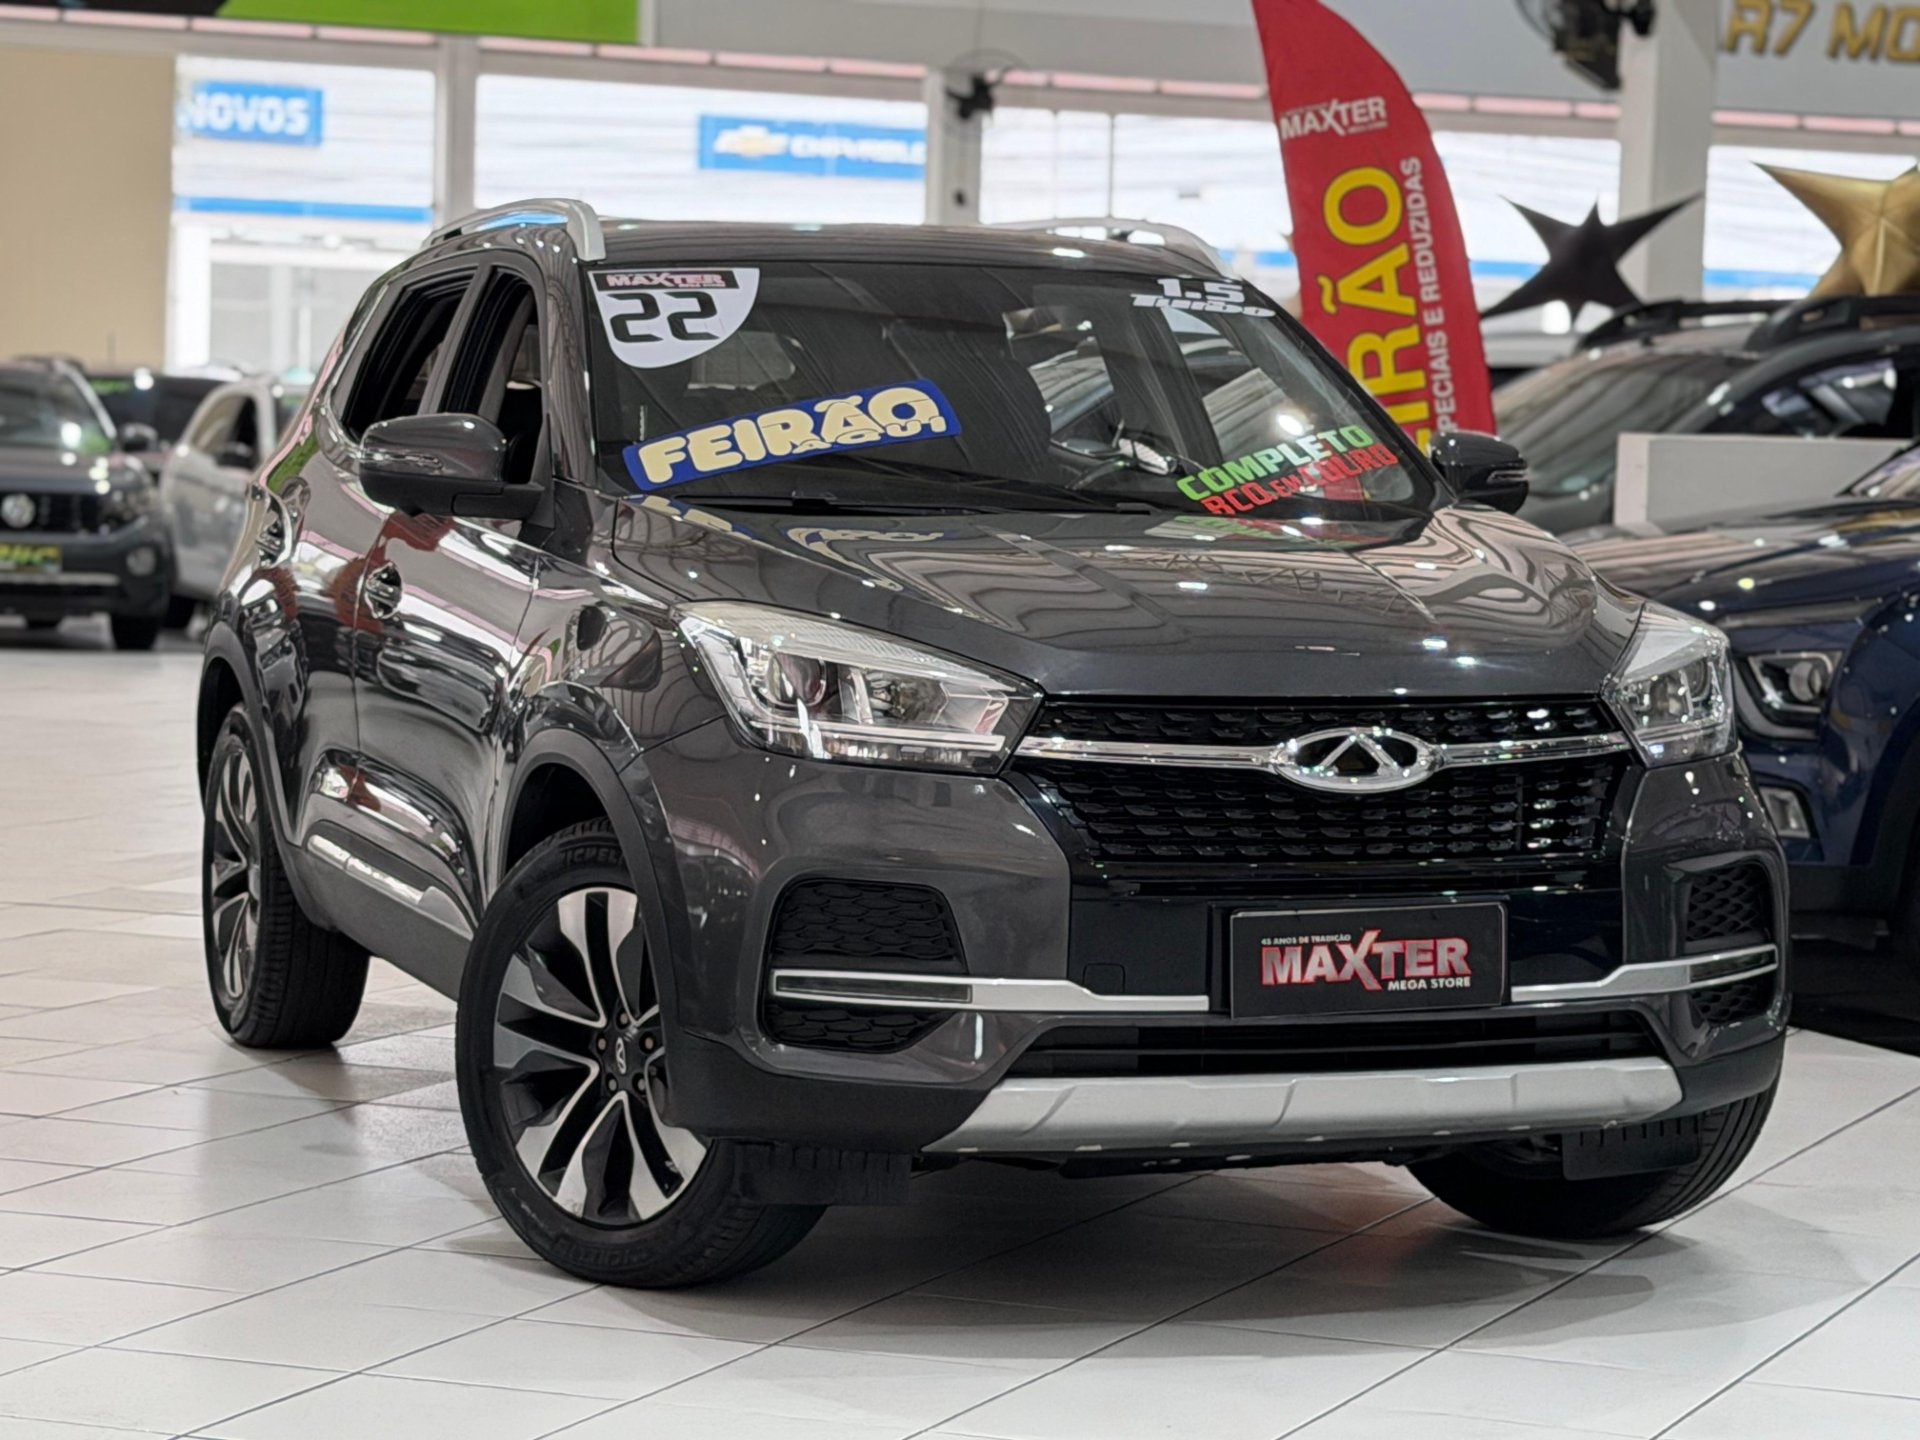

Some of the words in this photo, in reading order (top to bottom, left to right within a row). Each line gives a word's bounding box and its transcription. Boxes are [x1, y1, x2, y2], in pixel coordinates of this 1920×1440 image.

[1279, 96, 1387, 140] MAXTER
[1400, 156, 1441, 302] REDUZIDAS
[605, 272, 725, 288] MAXTER
[1157, 278, 1245, 303] 1.5
[606, 291, 721, 343] 22
[1422, 307, 1445, 326] E
[638, 387, 940, 484] FEIRÃO
[1176, 424, 1374, 500] COMPLETO
[1261, 929, 1472, 991] MAXTER
[1298, 935, 1309, 944] DE
[1388, 978, 1427, 991] MEGA
[1430, 976, 1471, 989] STORE
